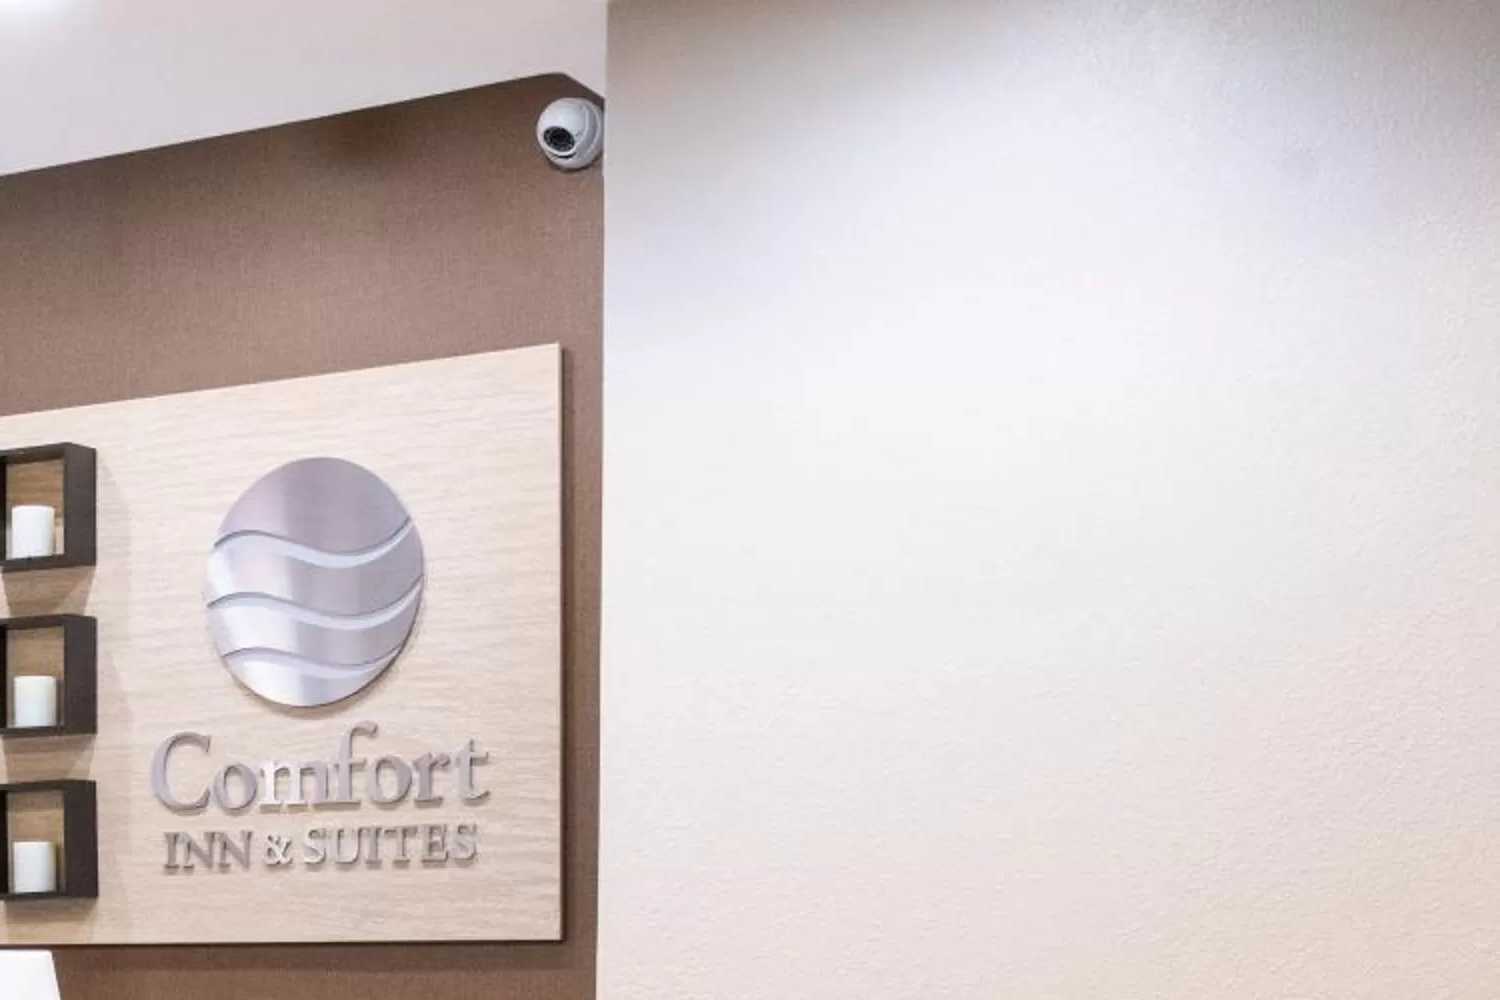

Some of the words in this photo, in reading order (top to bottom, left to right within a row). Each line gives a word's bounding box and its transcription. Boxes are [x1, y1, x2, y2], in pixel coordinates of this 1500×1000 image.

[151, 720, 490, 814] Comfort
[163, 831, 254, 872] INN
[263, 834, 294, 867] &
[303, 823, 479, 868] SUITES
